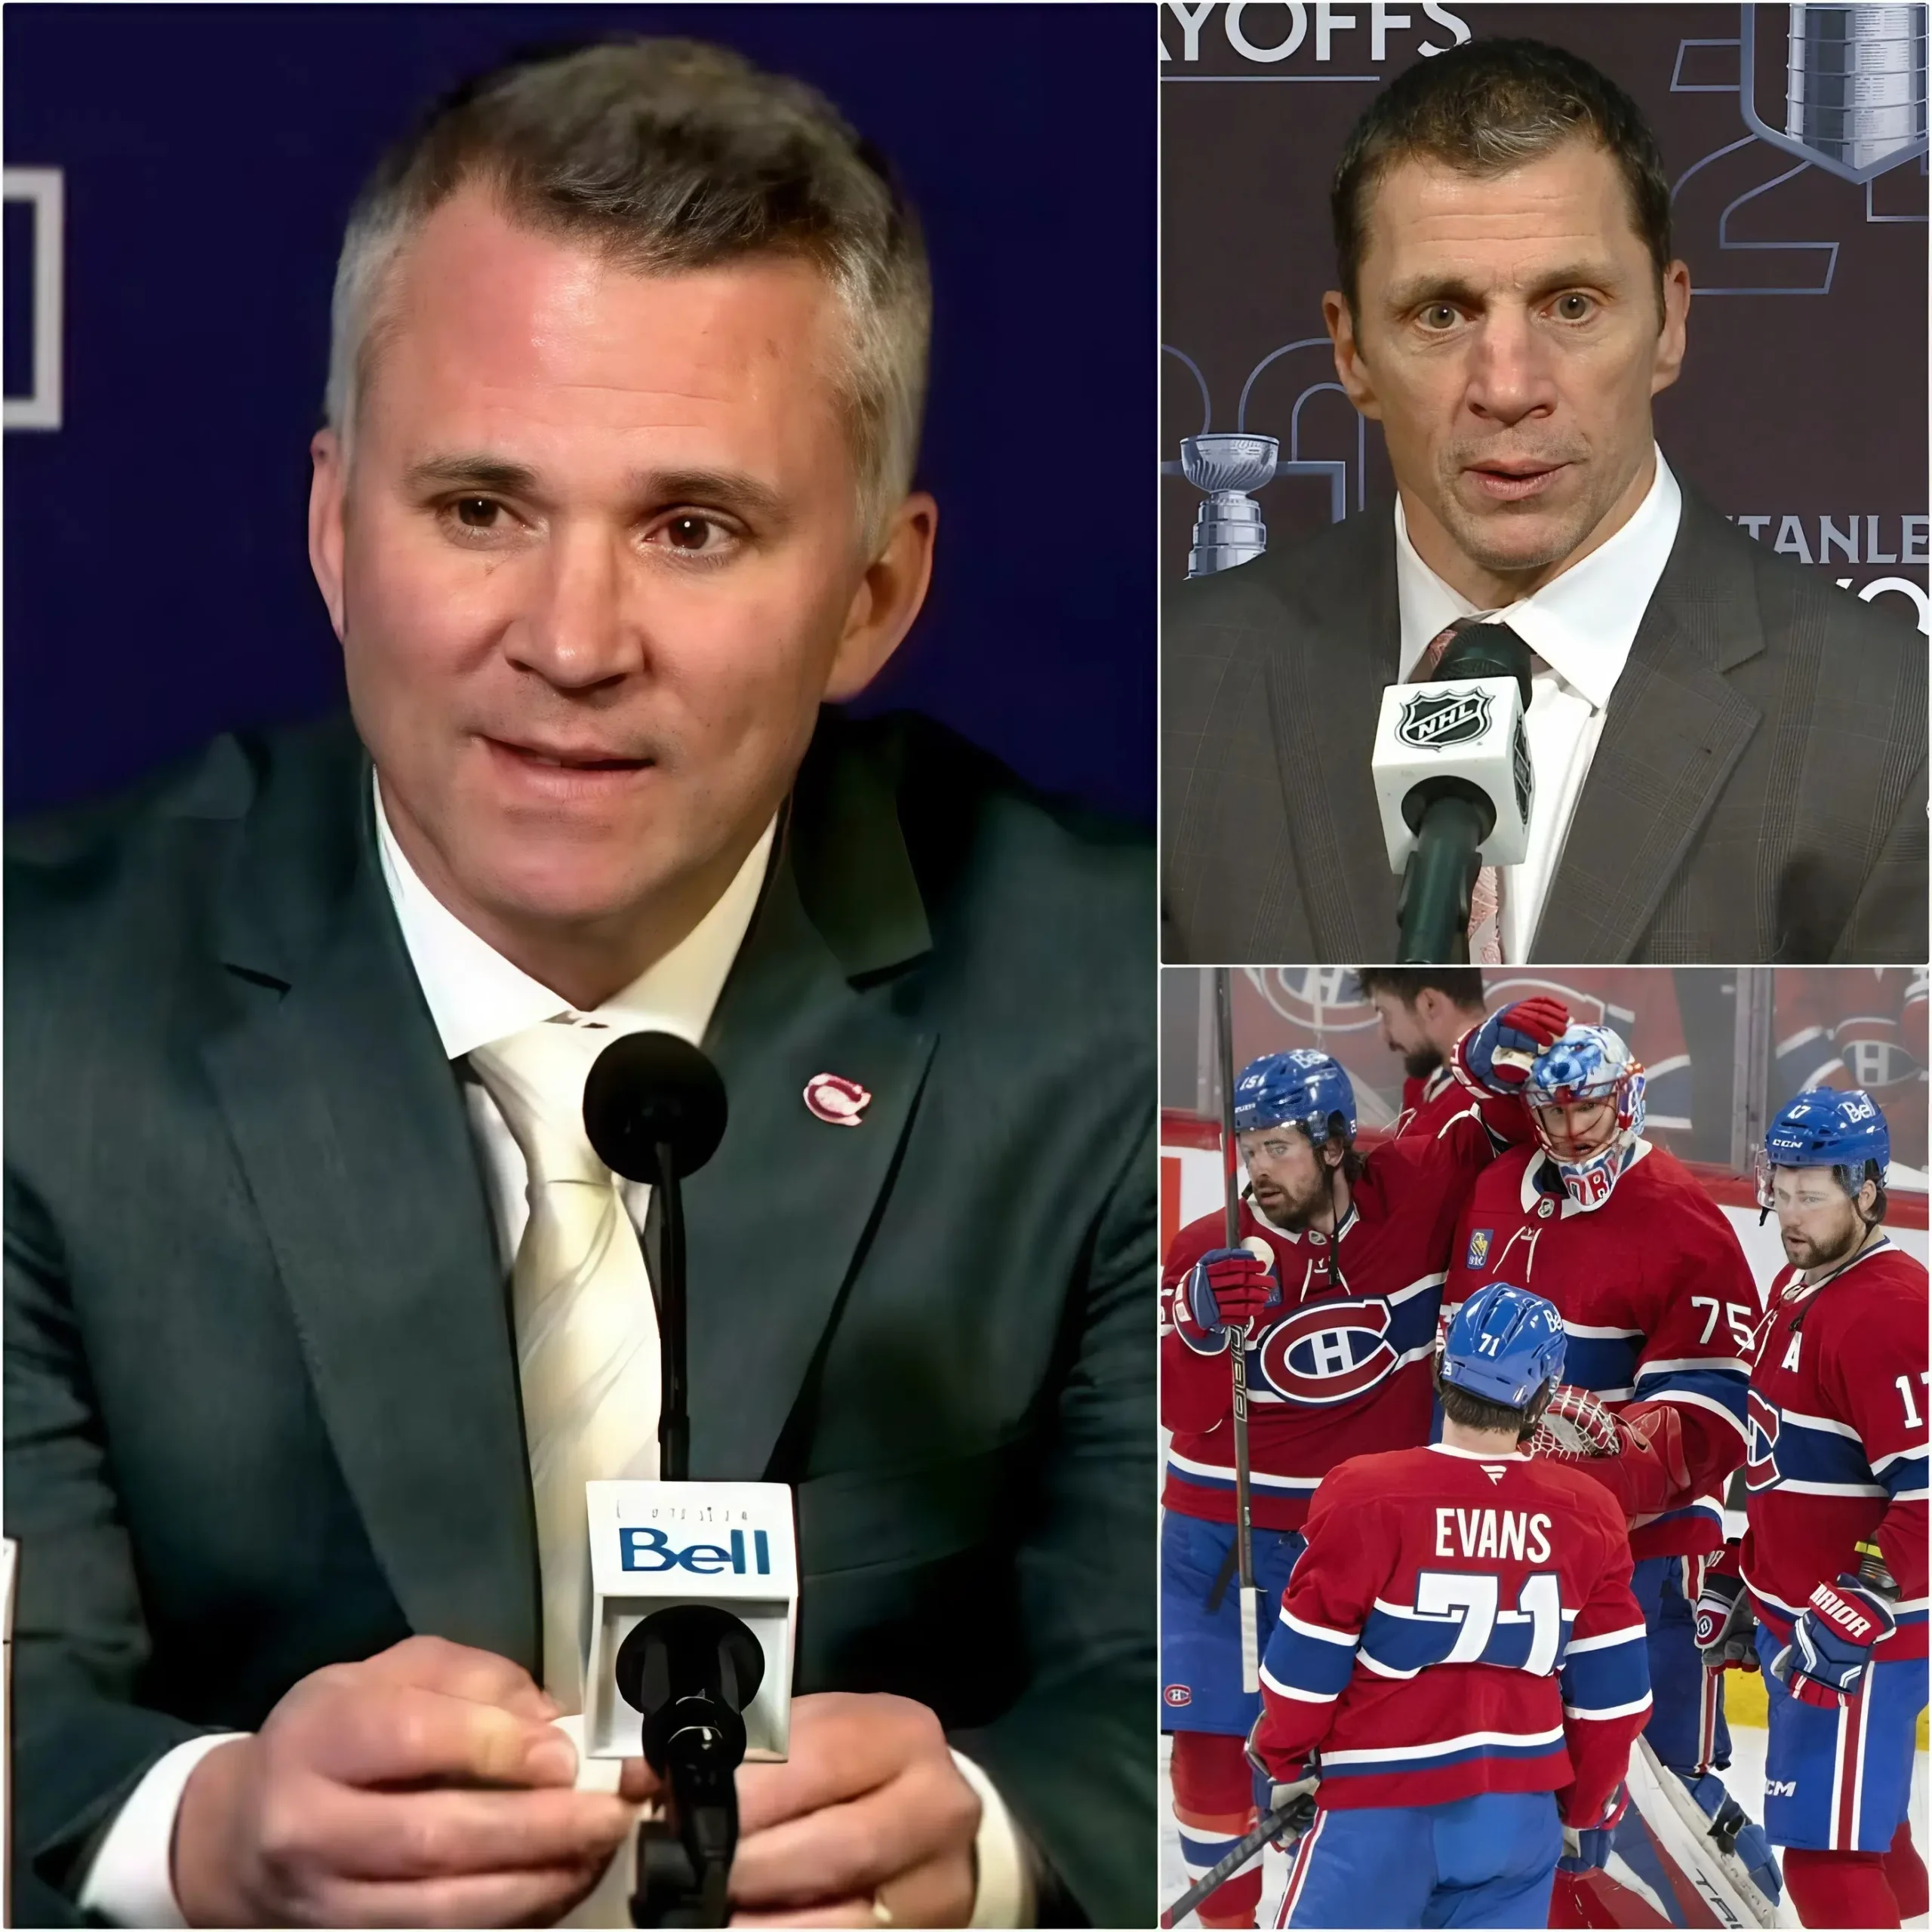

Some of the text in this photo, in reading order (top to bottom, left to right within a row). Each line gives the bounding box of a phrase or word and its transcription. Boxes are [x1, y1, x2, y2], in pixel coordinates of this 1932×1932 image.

[1725, 515, 1930, 564] TANLE
[1417, 704, 1474, 740] NHL
[1478, 1332, 1500, 1357] 71
[1692, 1296, 1755, 1351] 75
[1781, 1331, 1803, 1374] A
[618, 1527, 771, 1575] Bell
[1435, 1507, 1552, 1564] EVANS
[1415, 1572, 1560, 1678] 71
